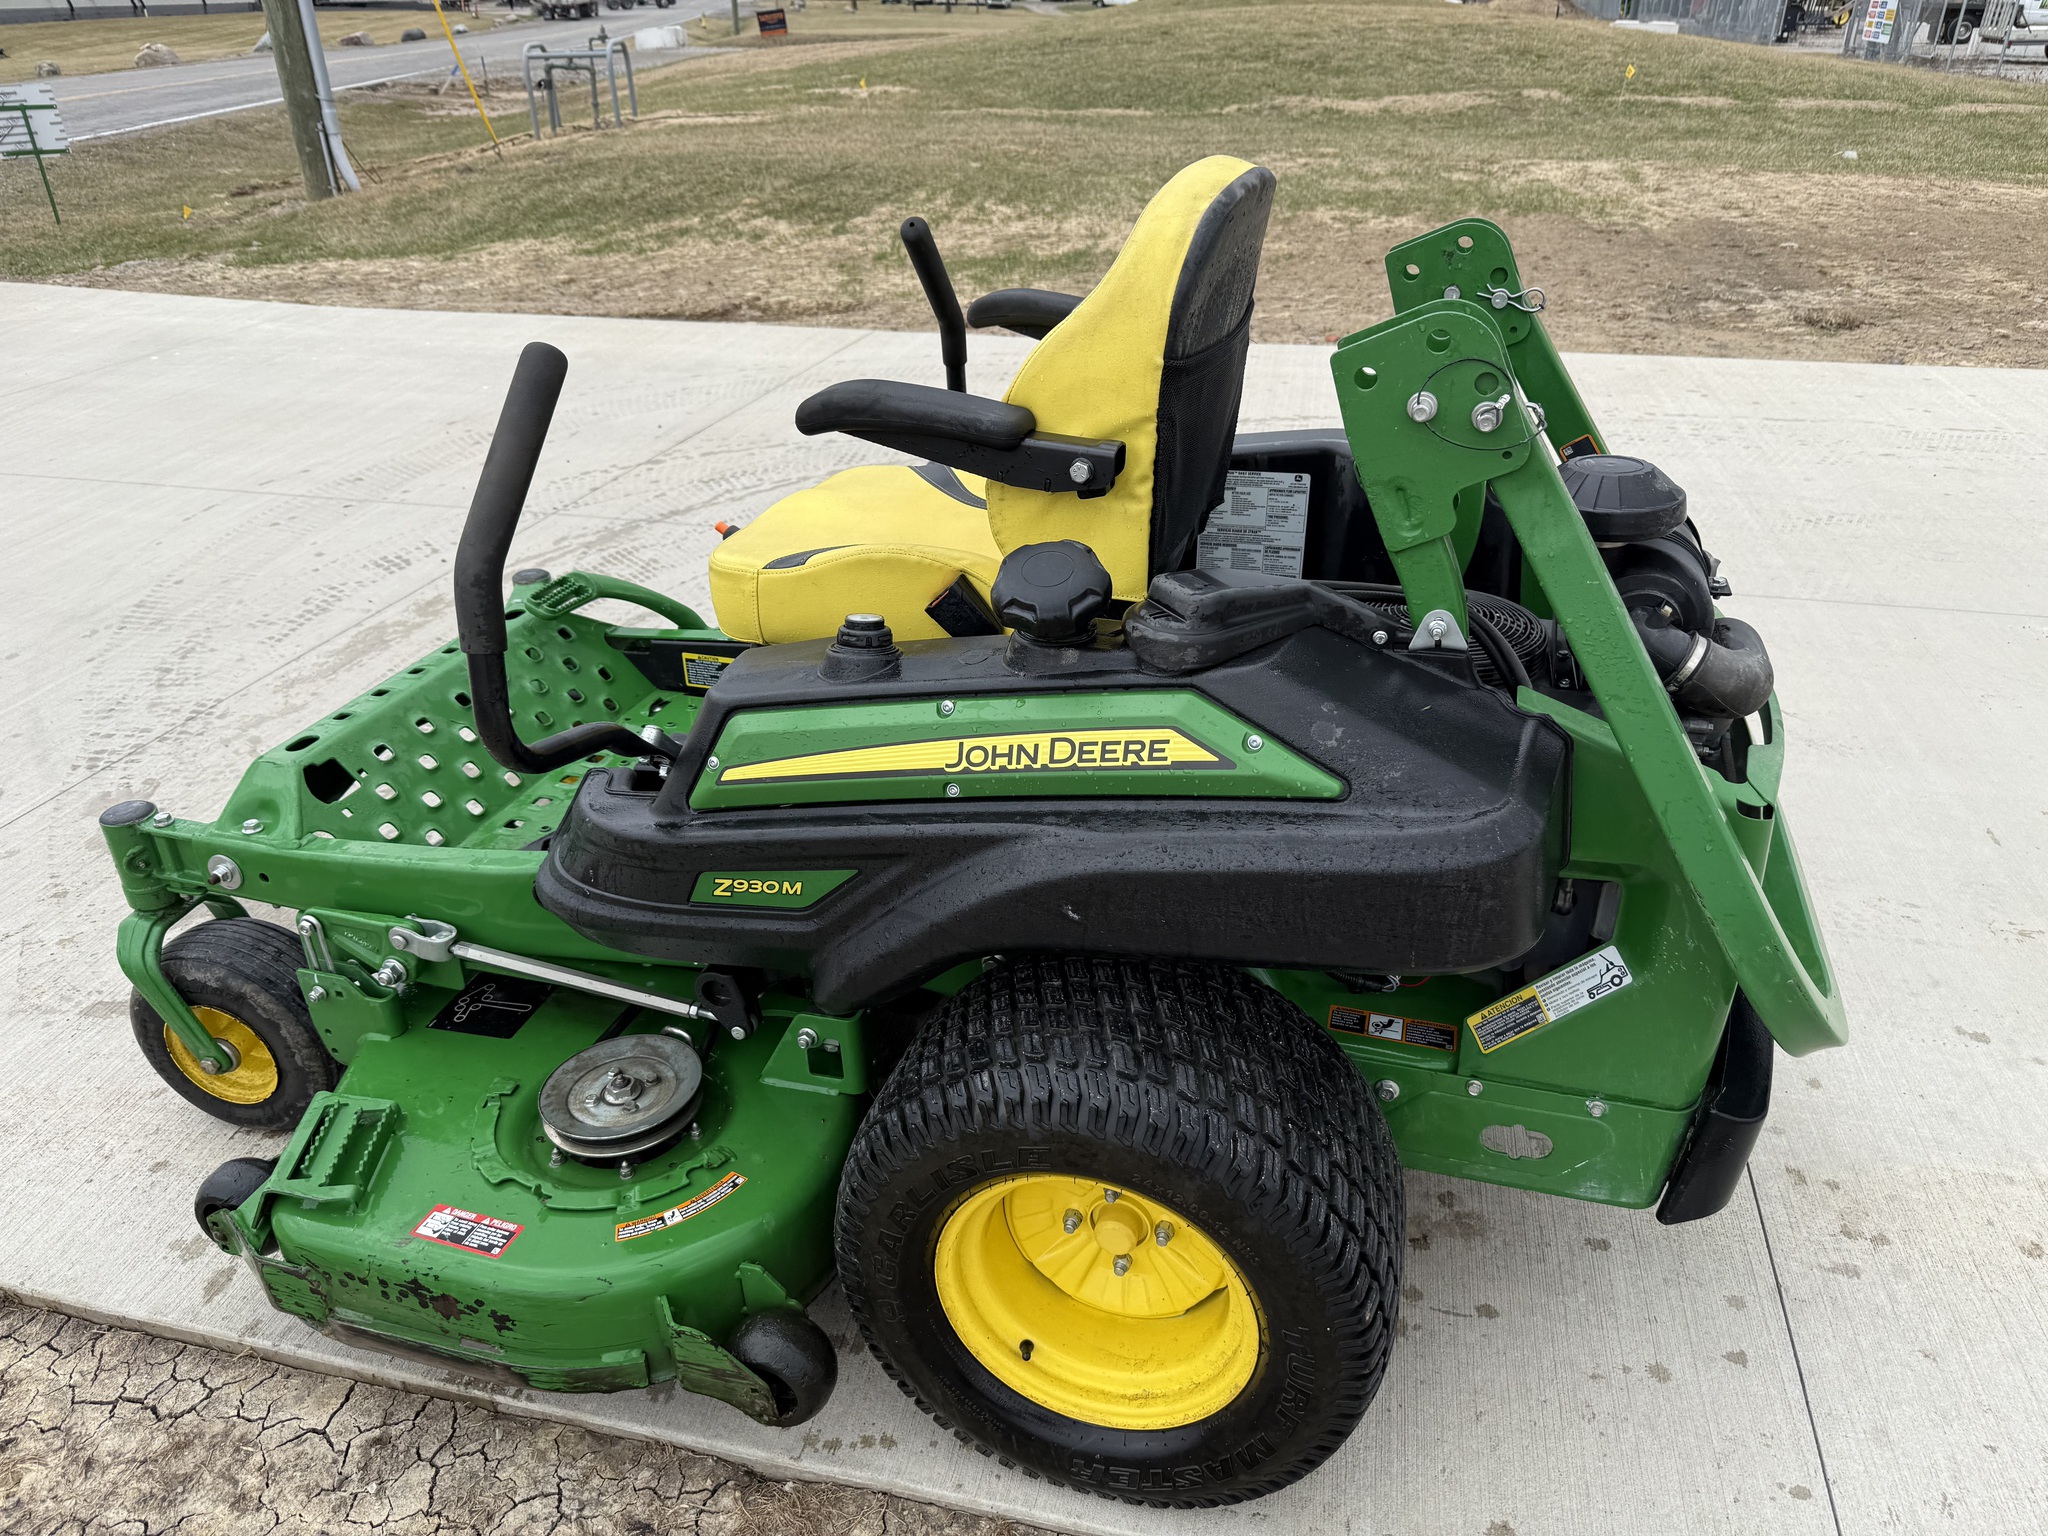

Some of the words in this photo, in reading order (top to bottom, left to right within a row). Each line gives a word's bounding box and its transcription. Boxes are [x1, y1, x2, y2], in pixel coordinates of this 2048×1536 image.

[945, 742, 1039, 769] JOHN
[1049, 737, 1170, 765] DEERE
[1487, 994, 1523, 1017] ATENCION
[451, 1208, 477, 1220] DANGER
[491, 1219, 517, 1231] PELIGRO
[874, 1146, 1051, 1289] CARLISLE
[1275, 1326, 1317, 1439] TURF
[1070, 1432, 1280, 1491] MASTER
